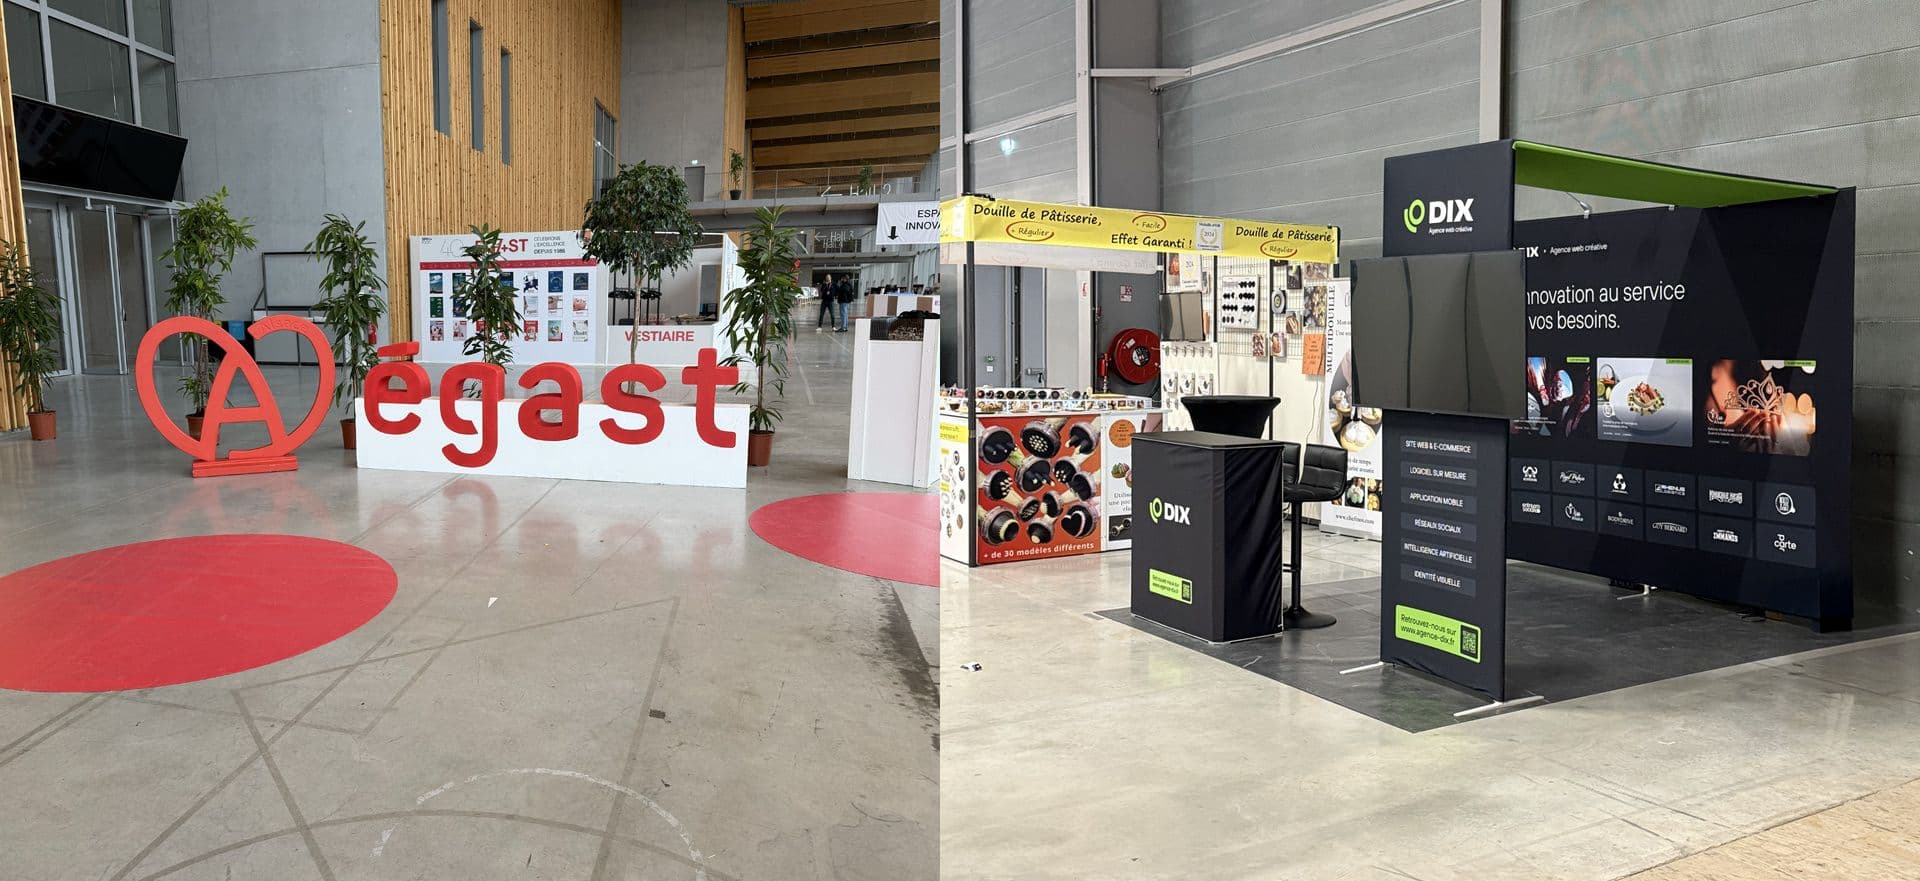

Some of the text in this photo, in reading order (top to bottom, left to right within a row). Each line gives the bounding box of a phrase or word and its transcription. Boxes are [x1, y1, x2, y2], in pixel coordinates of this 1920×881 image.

[974, 204, 1102, 226] Douille de Pâtisserie,
[1428, 198, 1474, 224] DIX
[1018, 227, 1050, 238] Régulier
[1142, 221, 1160, 229] Facile
[1112, 233, 1139, 245] Effet
[1142, 236, 1186, 248] Garanti
[1188, 240, 1192, 248] !
[1236, 226, 1335, 243] Douille de Pâtisserie,
[1550, 247, 1571, 256] Agence
[1600, 287, 1618, 302] au
[1623, 280, 1686, 302] service
[1528, 310, 1620, 330] vos besoins.
[624, 330, 694, 343] VESTIAIRE
[1326, 286, 1336, 373] MULTIDOUILLE
[364, 341, 739, 468] égast
[1434, 443, 1472, 453] E-COMMERCE
[1410, 466, 1432, 476] LOGICIEL
[1444, 471, 1467, 480] MESURE
[1410, 492, 1464, 507] APPLICATION MOBILE
[1164, 502, 1190, 525] DIX
[1414, 519, 1461, 534] RÉSEAUX SOCIAUX
[1054, 542, 1094, 552] différents
[1404, 543, 1472, 564] INTELLIGENCE ARTIFICIELLE
[1414, 570, 1461, 588] IDENTITÉ VISUELLE
[1401, 614, 1446, 633] Retrouvez-nous
[1401, 626, 1455, 645] www.agence-dix.fr
